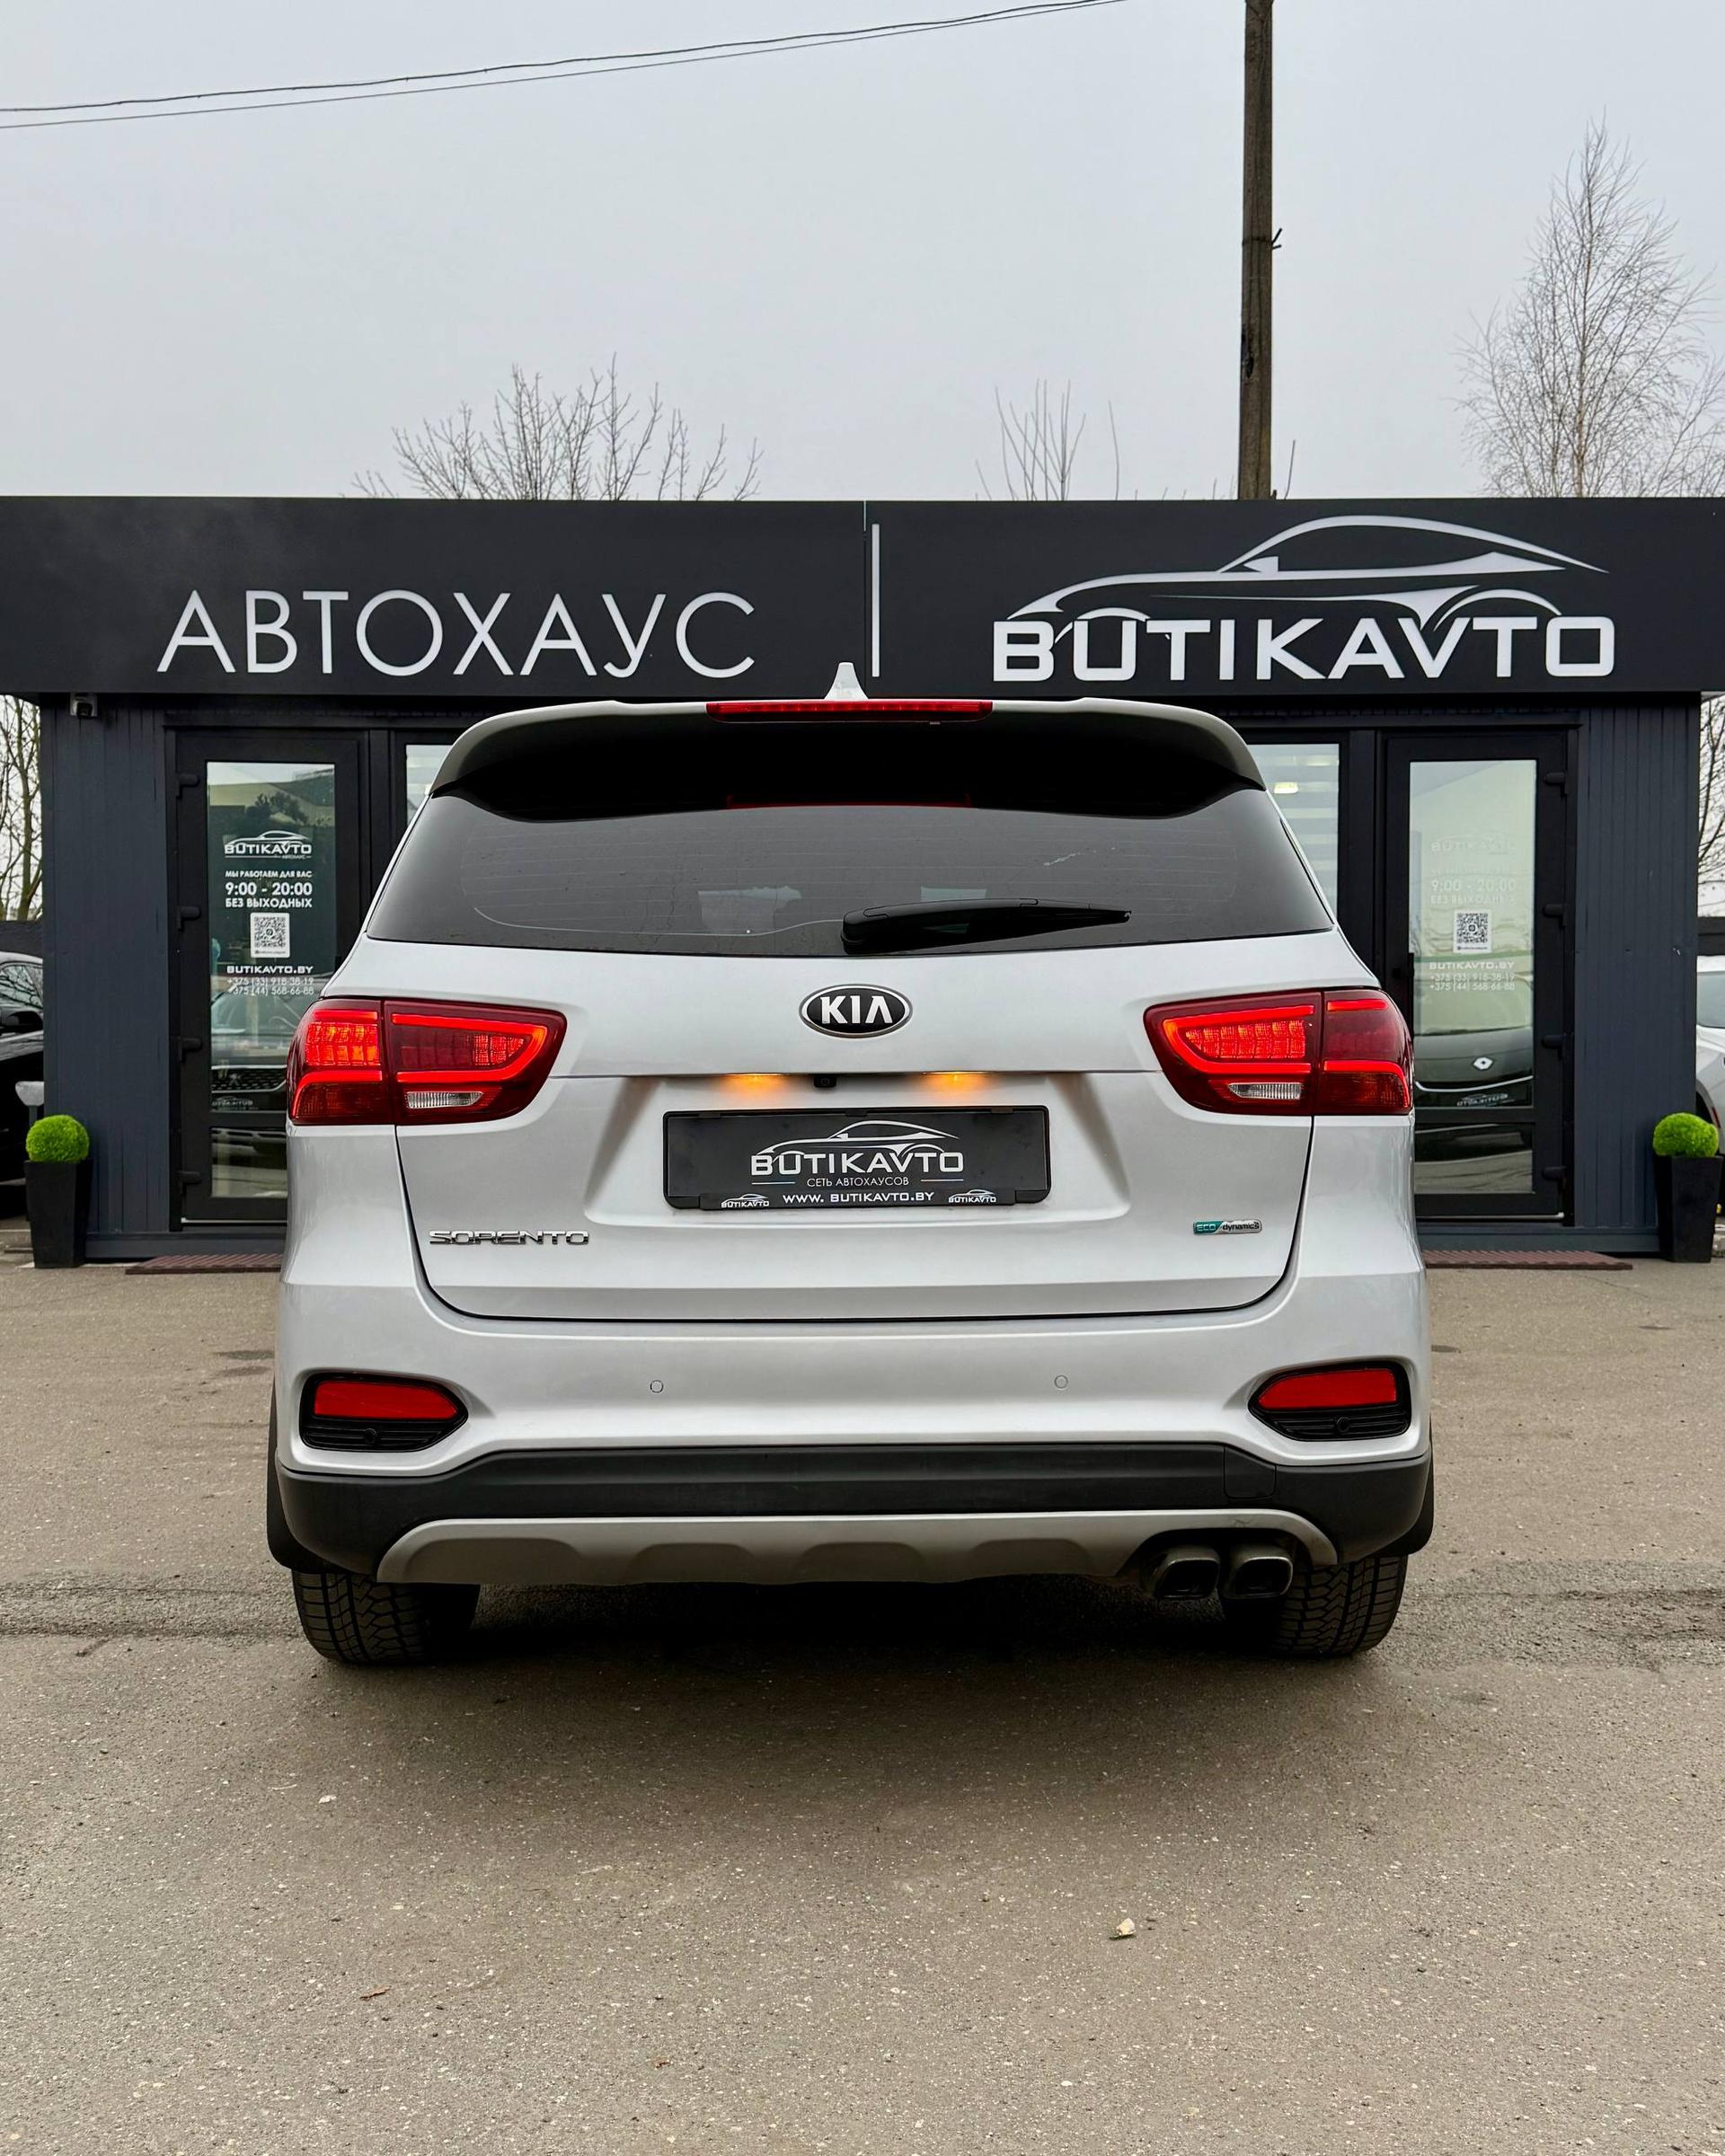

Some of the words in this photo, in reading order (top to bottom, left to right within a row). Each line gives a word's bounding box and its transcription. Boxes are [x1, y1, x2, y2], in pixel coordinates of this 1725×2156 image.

[157, 589, 755, 678] АВТОХАУС
[993, 615, 1614, 682] BUTIKAVTO
[225, 844, 312, 854] BUTIKAVTO
[279, 870, 295, 879] ДЛЯ
[225, 881, 257, 896] 9:00
[271, 881, 313, 896] 20:00
[1431, 879, 1461, 891] 9:00
[225, 897, 243, 907] БЕЗ
[246, 897, 313, 908] ВЫХОДНЫХ
[226, 965, 314, 974] BUTIKAVTO.BY
[1429, 961, 1515, 970] BUTIKAVTO.BY
[819, 994, 893, 1024] KIA
[751, 1152, 964, 1176] BUTIKAVTO
[807, 1178, 832, 1188] СЕТЬ
[836, 1177, 909, 1187] АВТОХАУСОВ
[783, 1194, 825, 1204] WWW.
[830, 1192, 934, 1202] BUTIKAVTO.BY
[948, 1196, 996, 1204] BUTIKAVTO
[721, 1200, 770, 1208] BUTIKAVTO
[1222, 1222, 1260, 1232] dynamics
[429, 1231, 589, 1245] SORENTO
